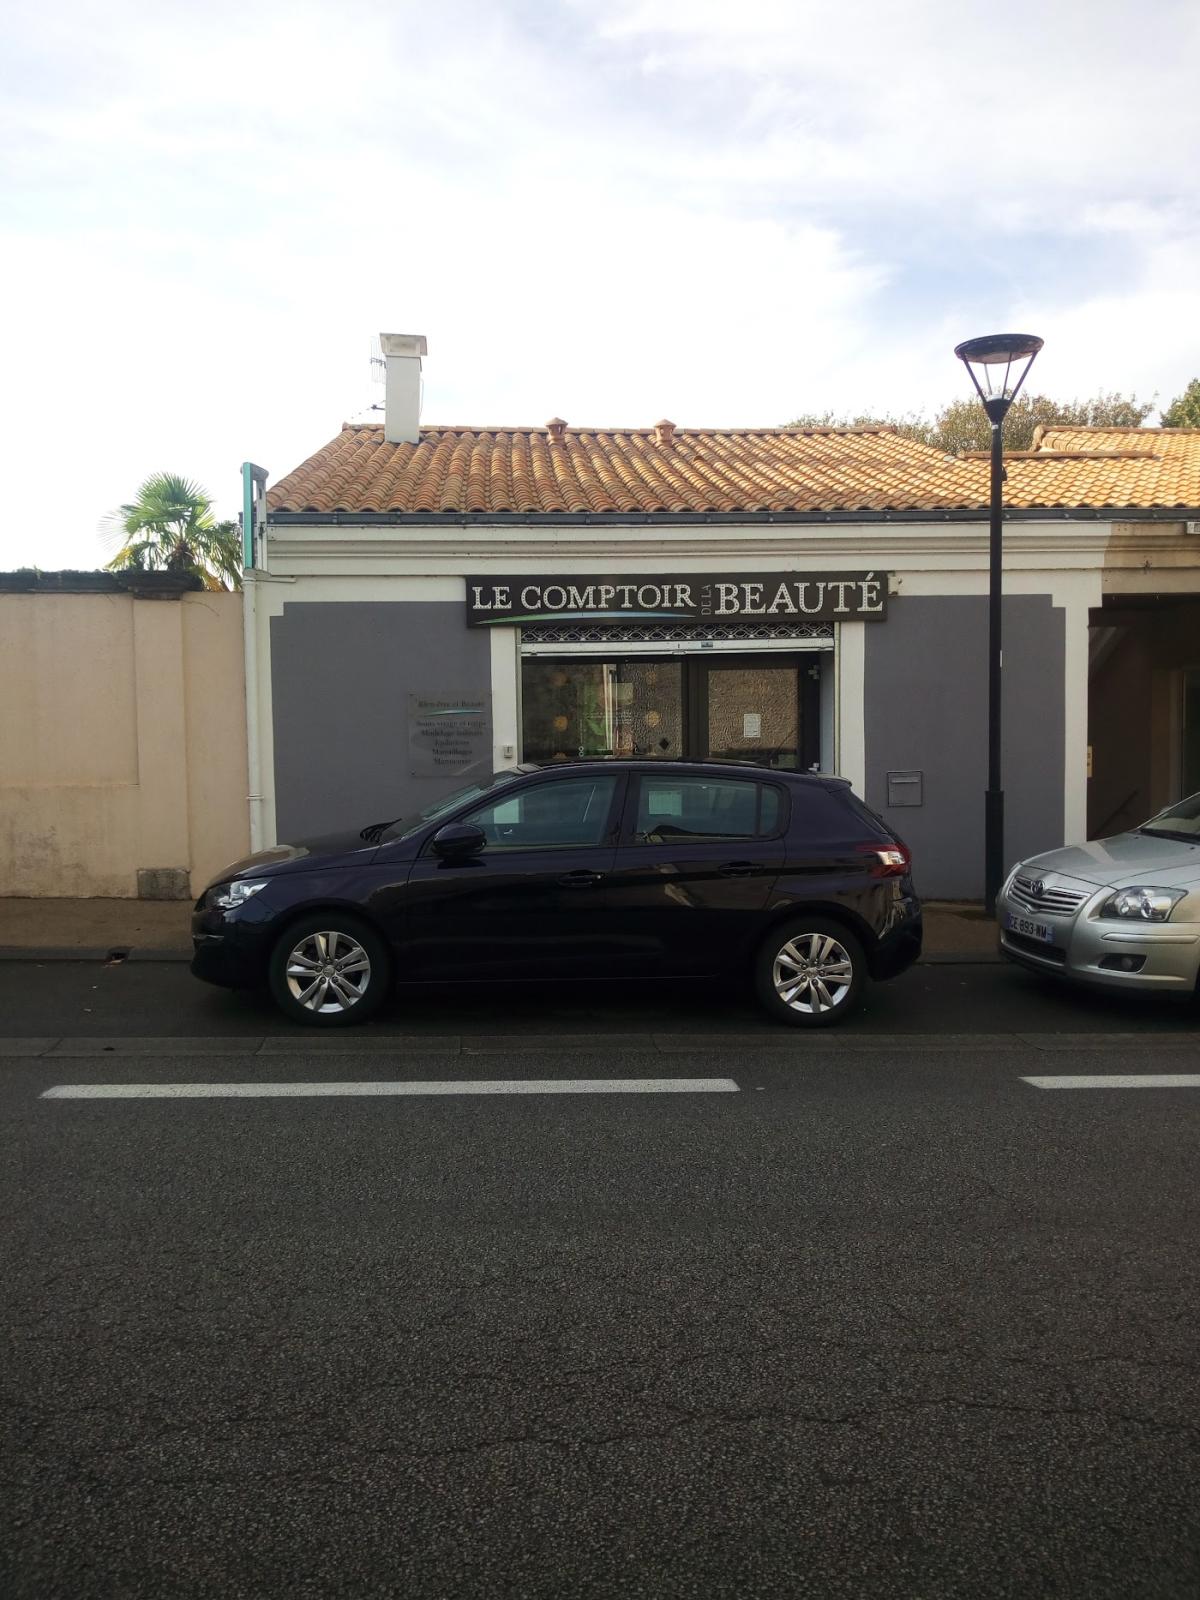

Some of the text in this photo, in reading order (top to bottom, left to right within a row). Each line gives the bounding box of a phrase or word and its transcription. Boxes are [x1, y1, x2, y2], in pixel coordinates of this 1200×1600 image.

[472, 586, 512, 609] LE
[520, 584, 698, 610] COMPTOIR
[701, 584, 711, 598] LA
[715, 571, 884, 614] BEAUTÉ
